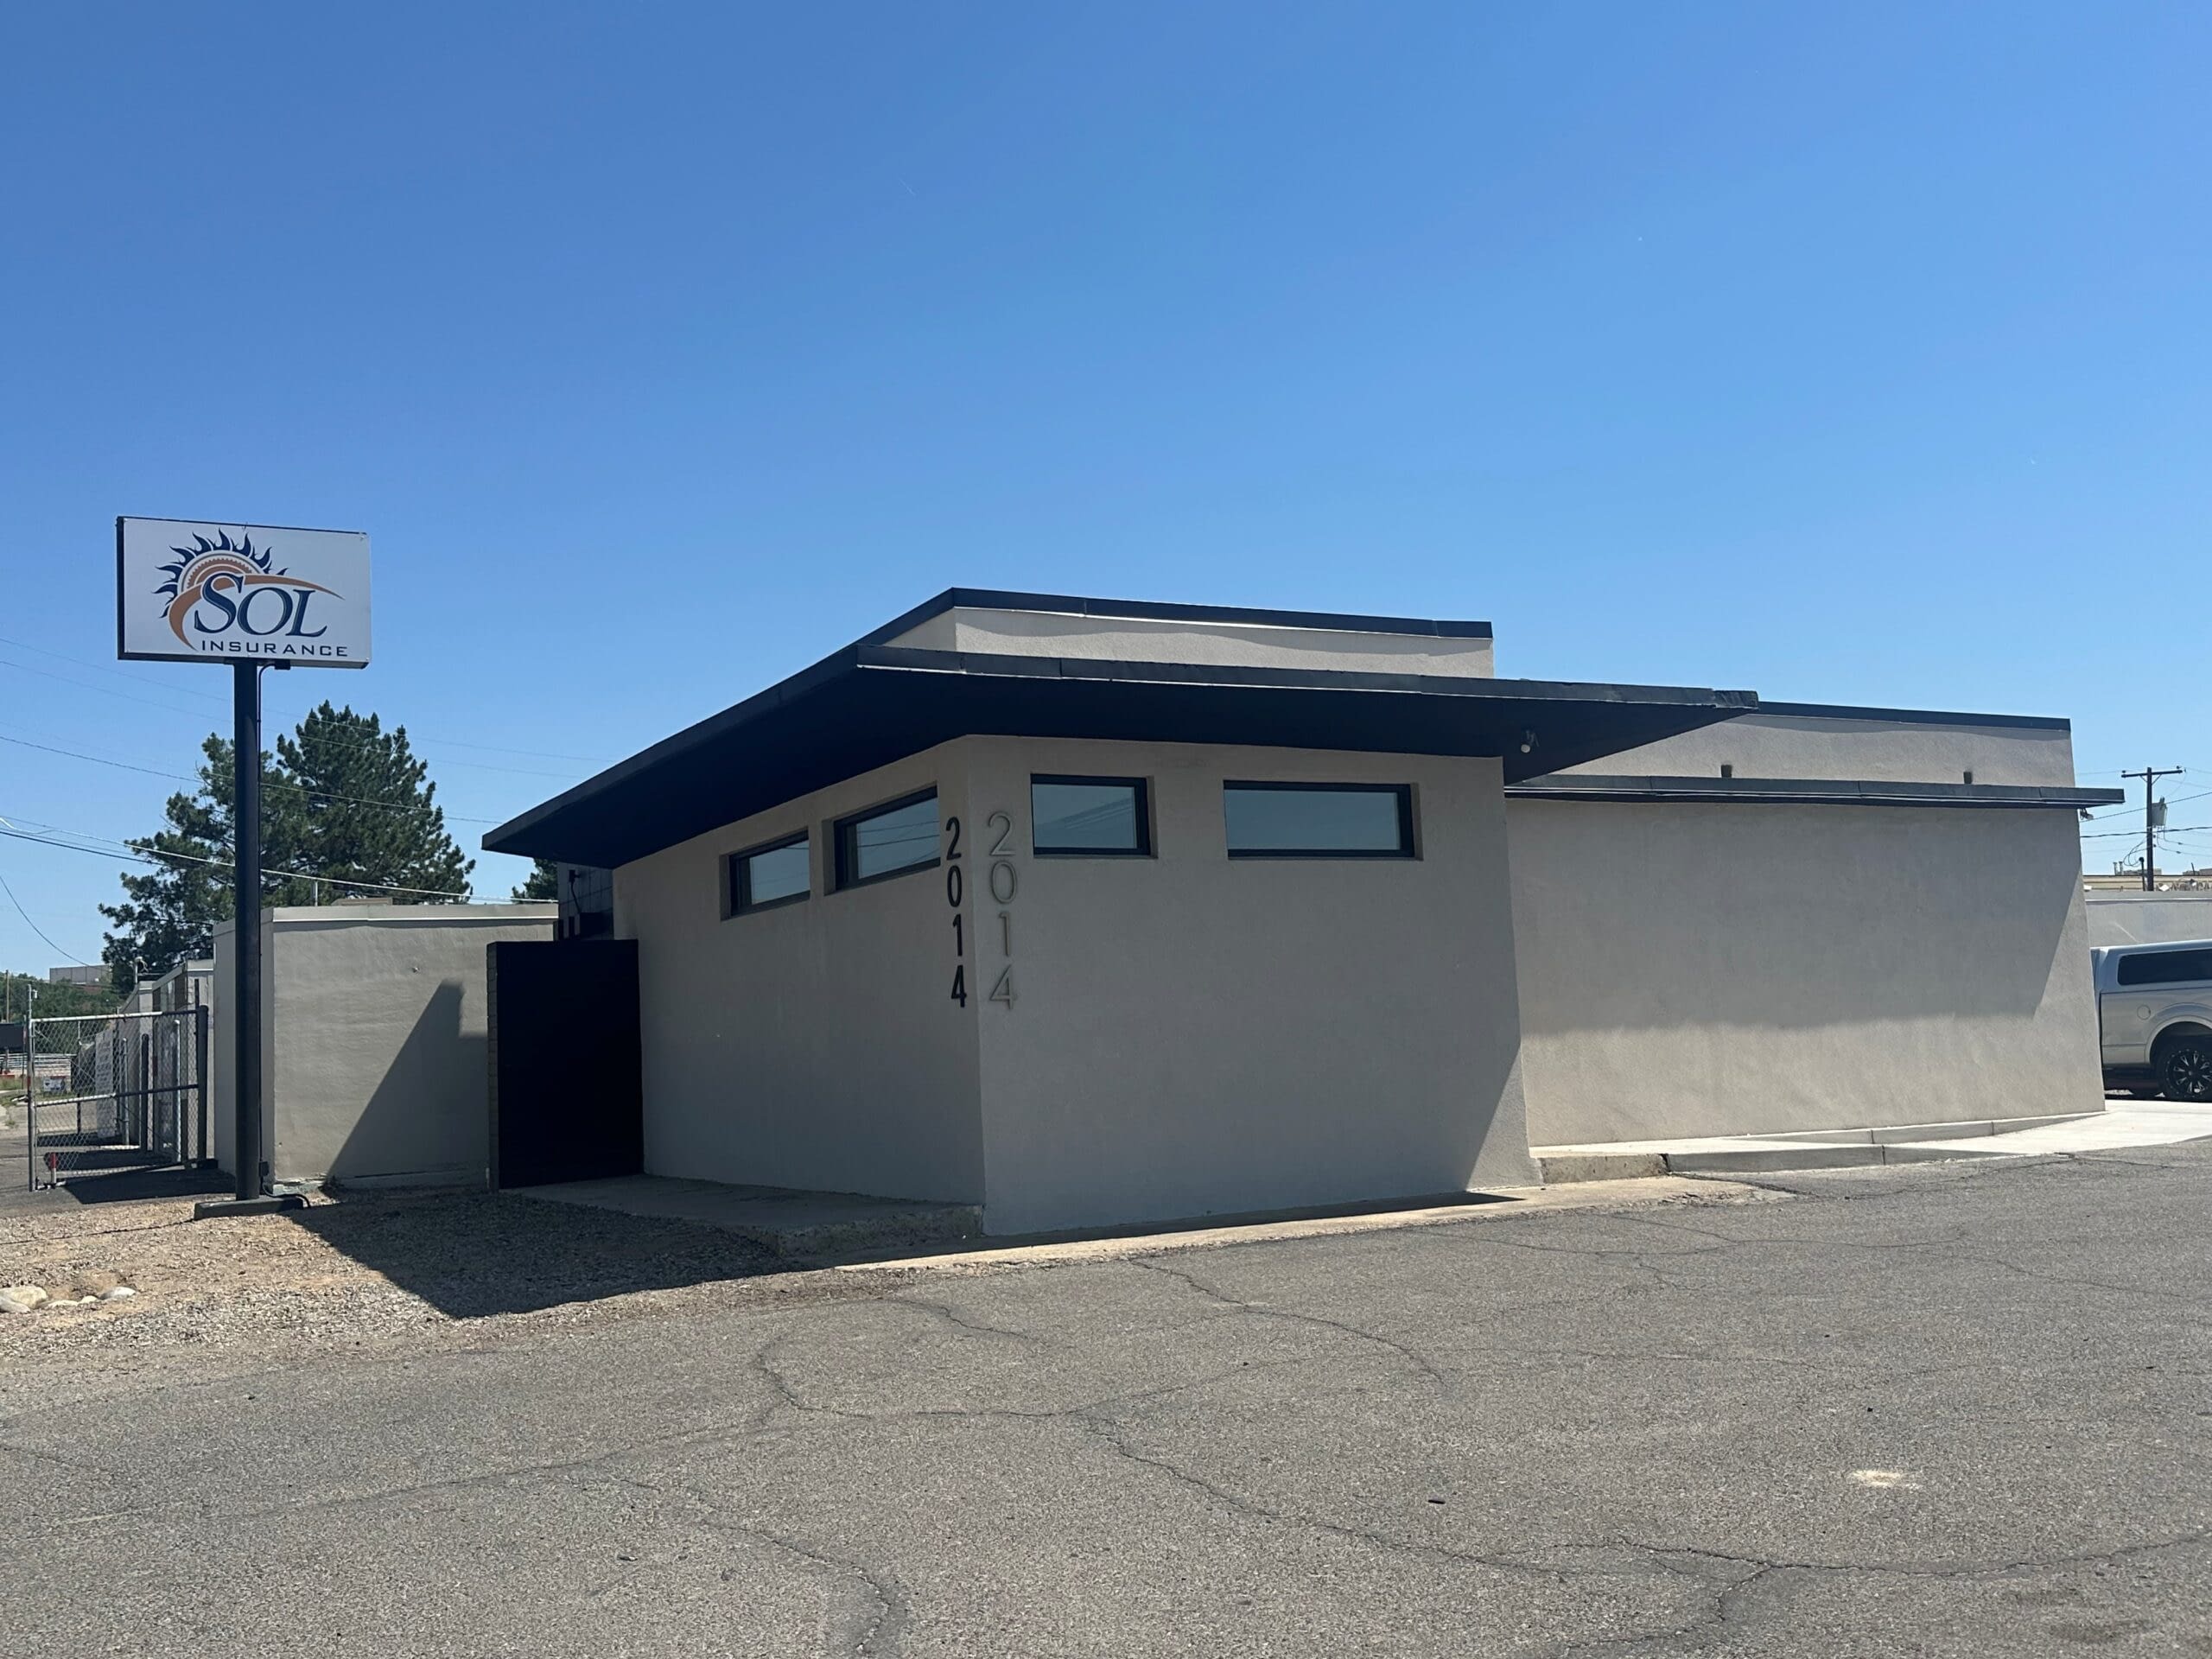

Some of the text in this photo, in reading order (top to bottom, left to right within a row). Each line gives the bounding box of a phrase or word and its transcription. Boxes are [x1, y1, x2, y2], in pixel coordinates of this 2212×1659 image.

[194, 573, 327, 638] SOL
[202, 640, 347, 657] INSURANCE
[945, 817, 967, 1007] 2014
[988, 811, 1017, 1009] 2014
